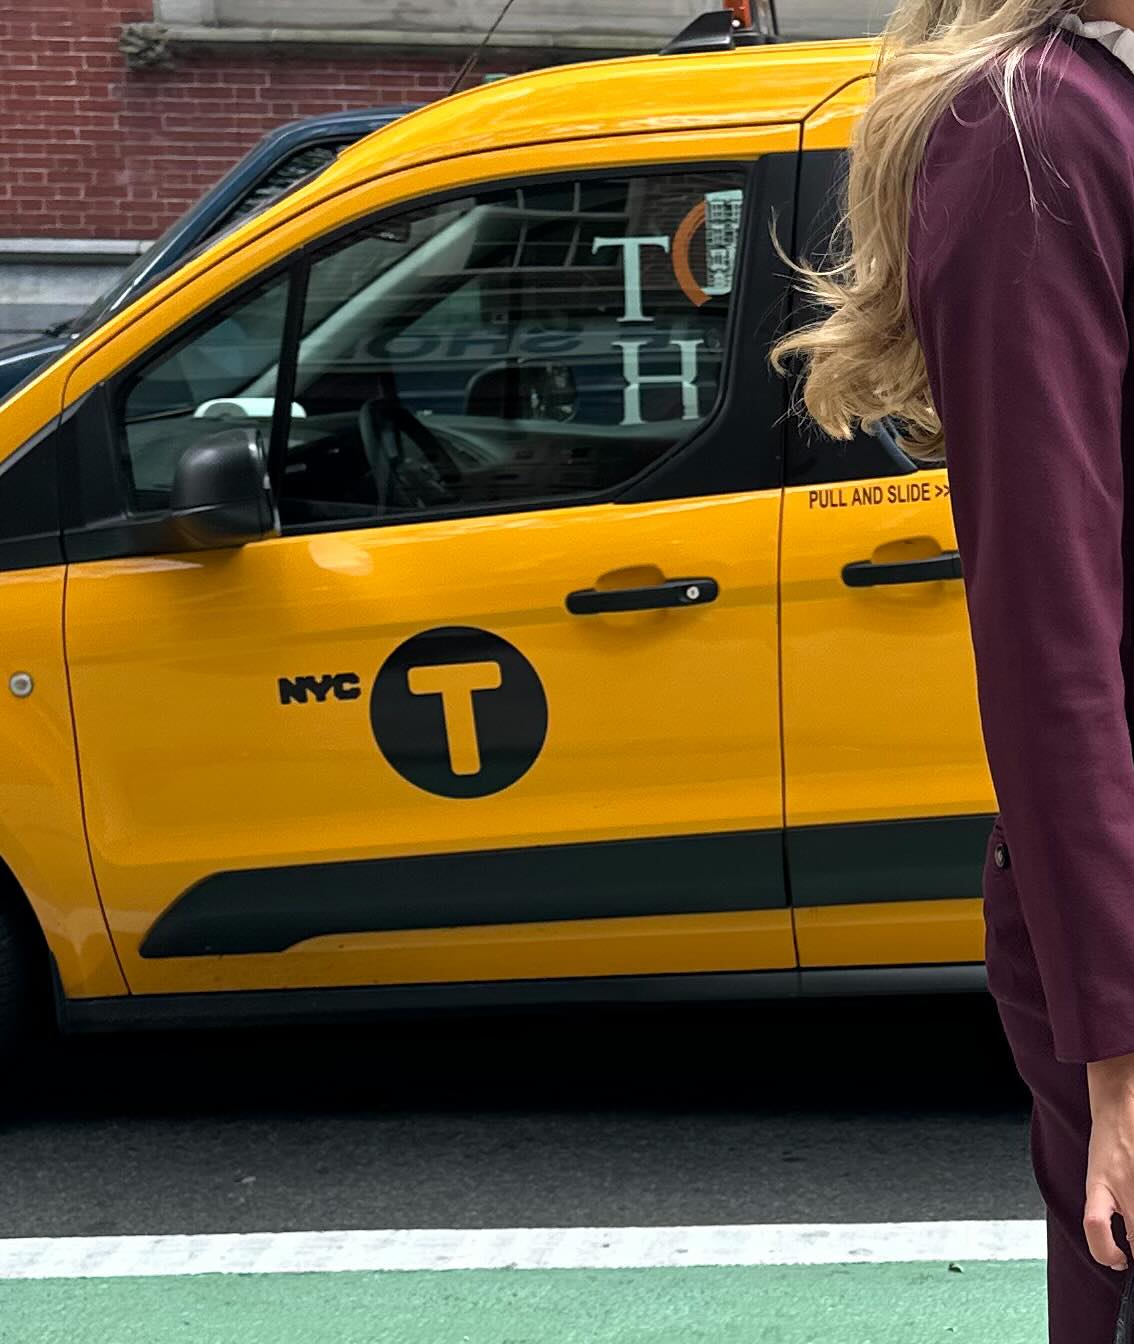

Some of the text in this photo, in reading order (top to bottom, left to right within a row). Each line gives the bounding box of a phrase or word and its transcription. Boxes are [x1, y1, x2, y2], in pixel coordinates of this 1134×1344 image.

[809, 483, 931, 509] PULL AND SLIDE
[278, 661, 502, 775] NYC T
